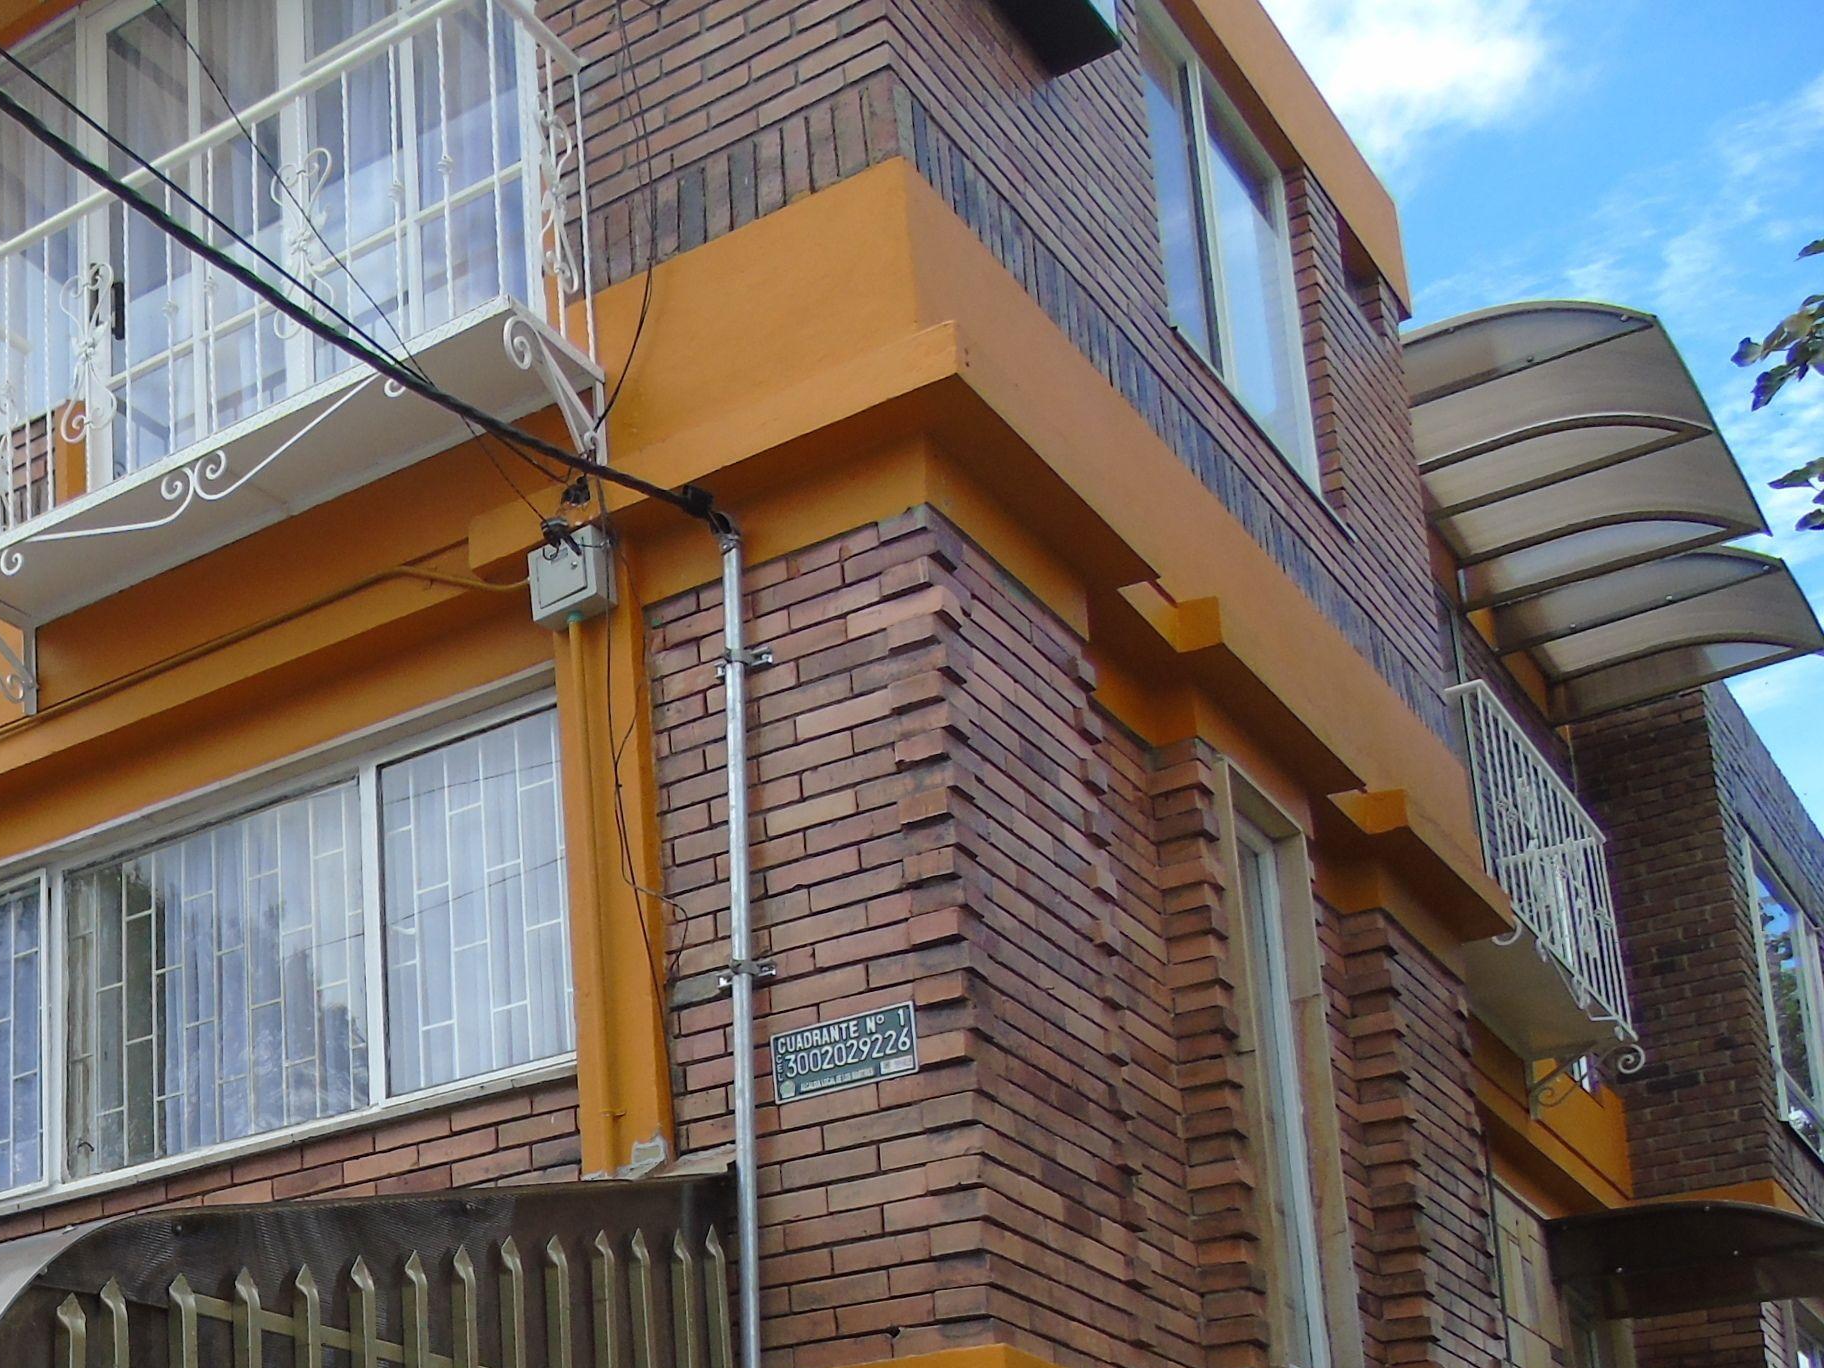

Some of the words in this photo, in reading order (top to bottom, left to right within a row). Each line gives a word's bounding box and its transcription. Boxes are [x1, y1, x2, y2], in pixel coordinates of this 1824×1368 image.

[777, 1021, 860, 1054] CUADRANTE
[897, 1008, 906, 1027] 1
[784, 1027, 911, 1078] 3002029226
